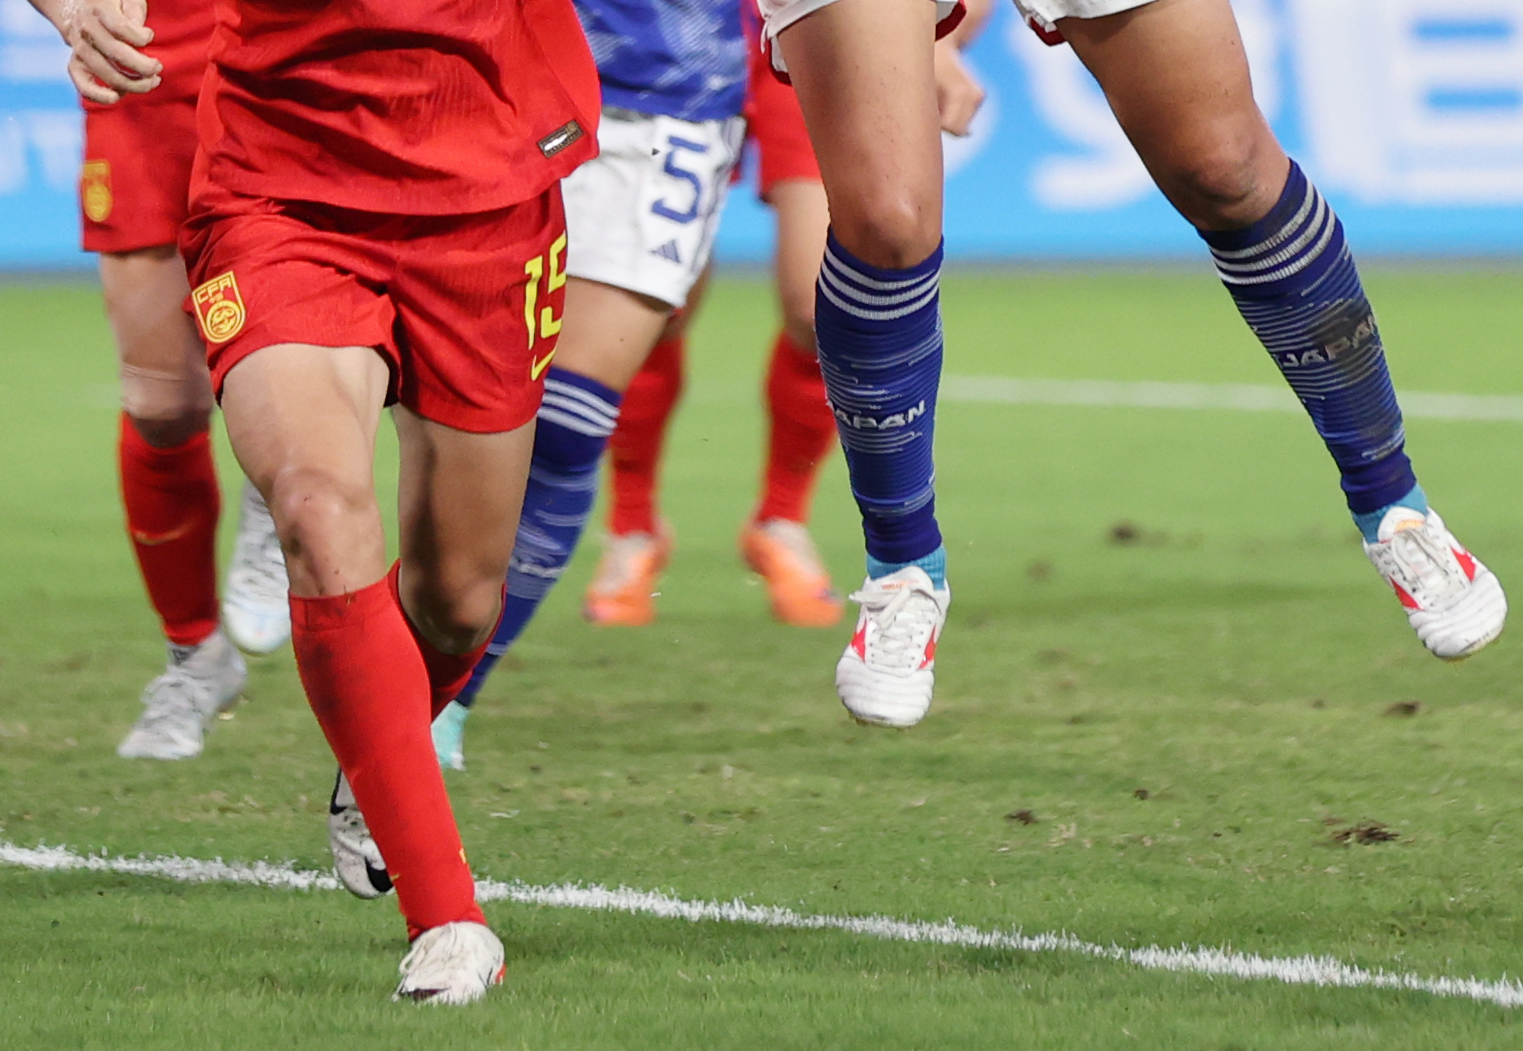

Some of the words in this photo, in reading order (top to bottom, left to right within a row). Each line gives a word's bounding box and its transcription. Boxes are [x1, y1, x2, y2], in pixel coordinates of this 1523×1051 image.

[651, 134, 708, 224] 5
[197, 276, 232, 304] CFA
[524, 229, 568, 350] 15
